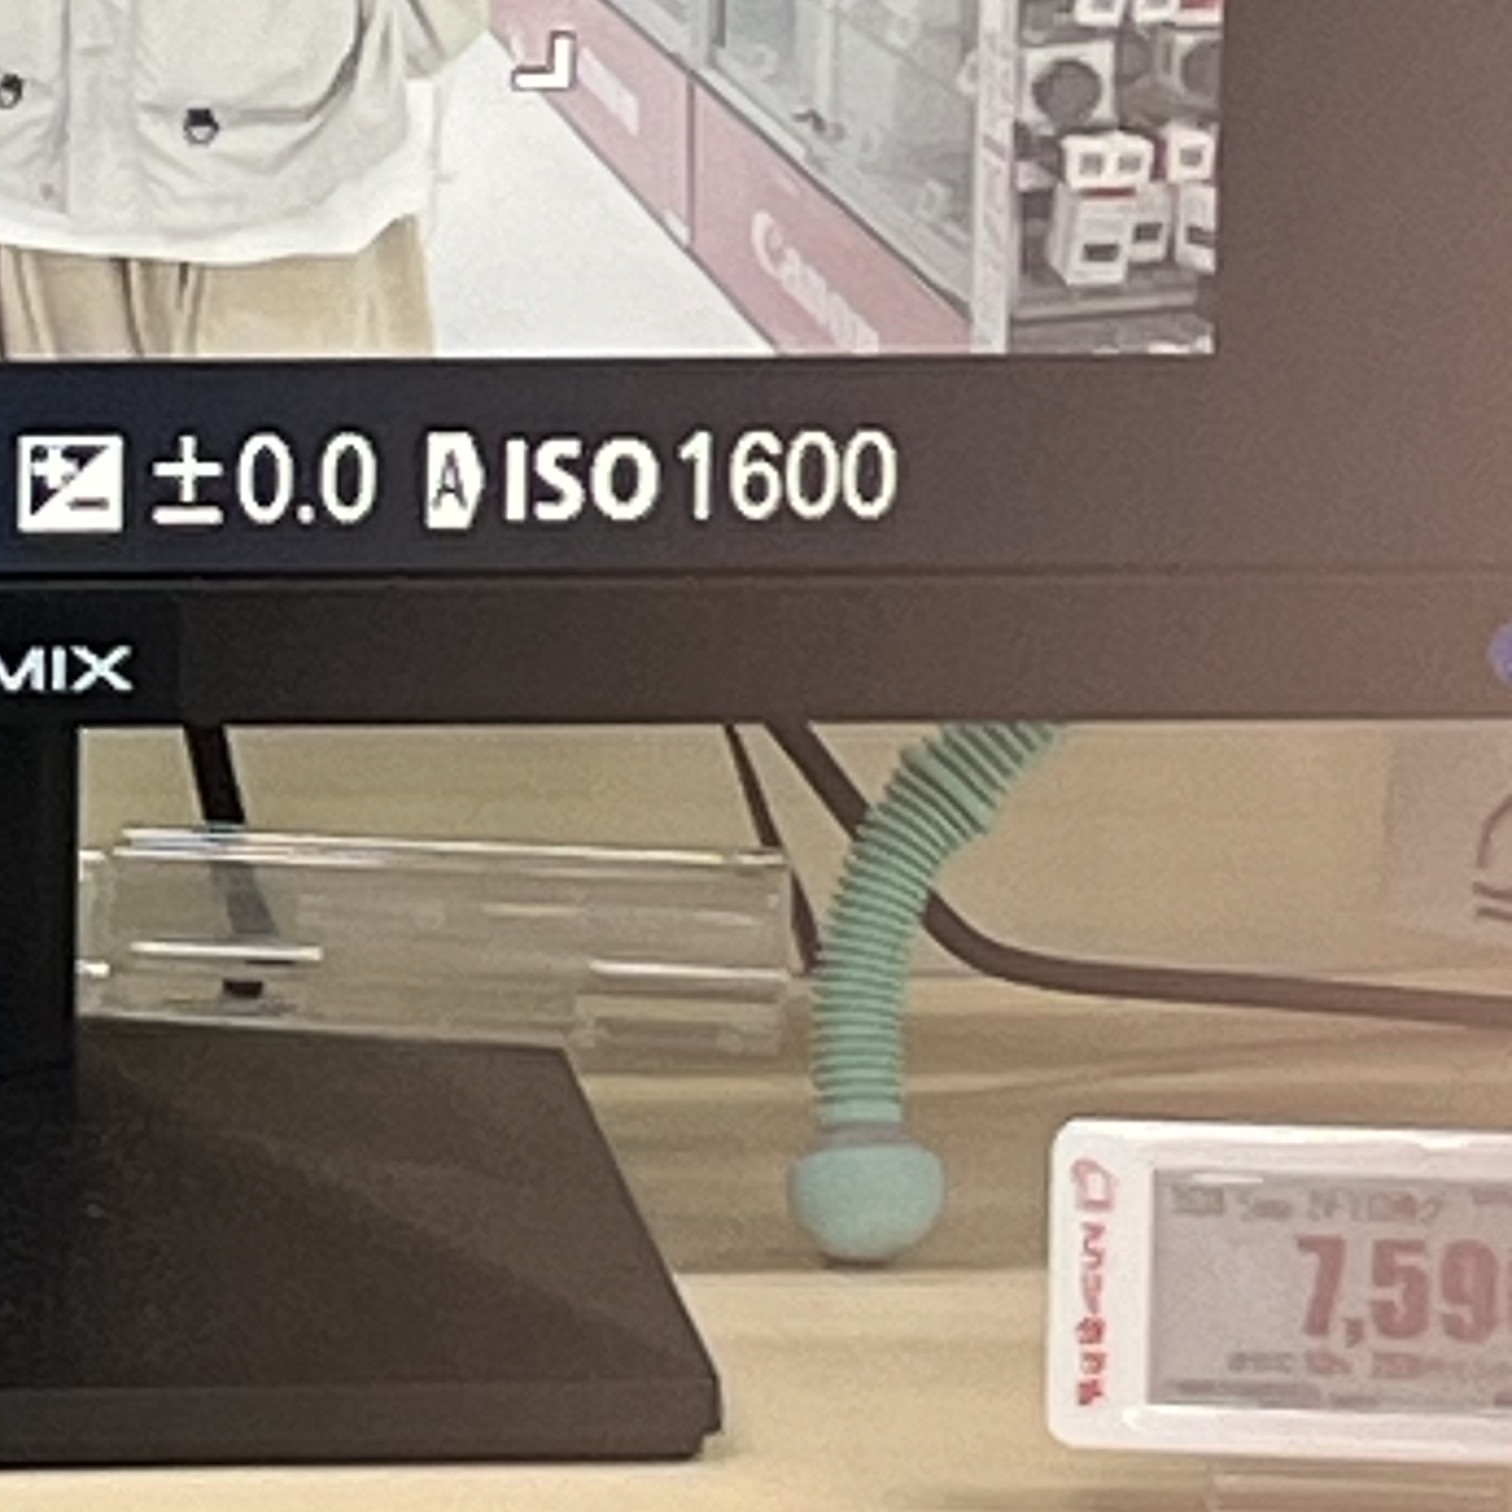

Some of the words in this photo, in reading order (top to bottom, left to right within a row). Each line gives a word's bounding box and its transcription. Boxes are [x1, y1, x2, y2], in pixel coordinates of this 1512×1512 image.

[150, 432, 378, 526] ±0.0
[504, 438, 662, 522] ISO
[678, 430, 898, 522] 1600
[1296, 1234, 1512, 1348] 7,59
